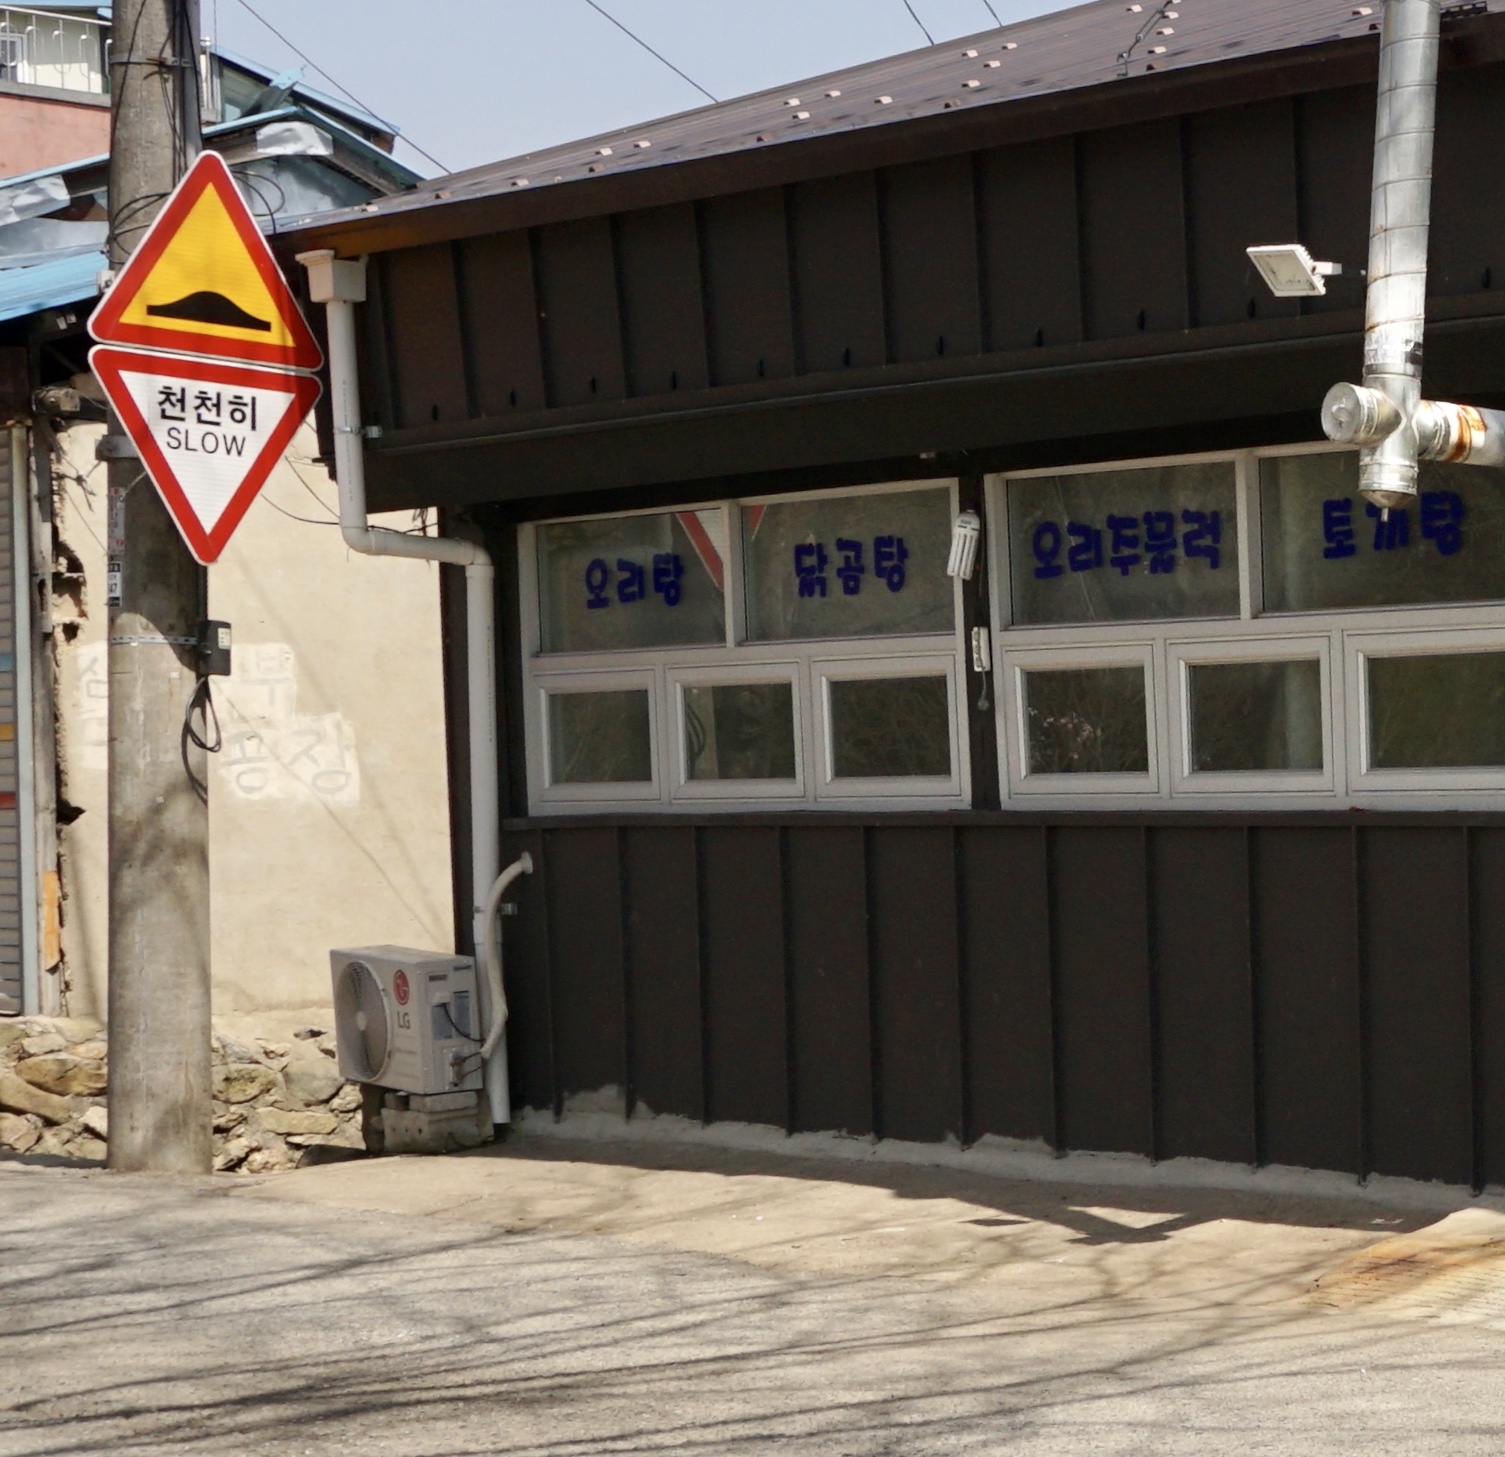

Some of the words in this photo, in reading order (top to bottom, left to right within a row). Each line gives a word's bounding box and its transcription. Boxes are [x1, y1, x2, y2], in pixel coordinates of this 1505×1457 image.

[158, 386, 257, 432] 천천히
[166, 426, 247, 457] SLOW
[794, 534, 909, 598] 닭곰탕
[1032, 510, 1222, 579] 오리주물럭
[585, 553, 684, 609] 오리탕
[396, 1011, 411, 1030] LG
